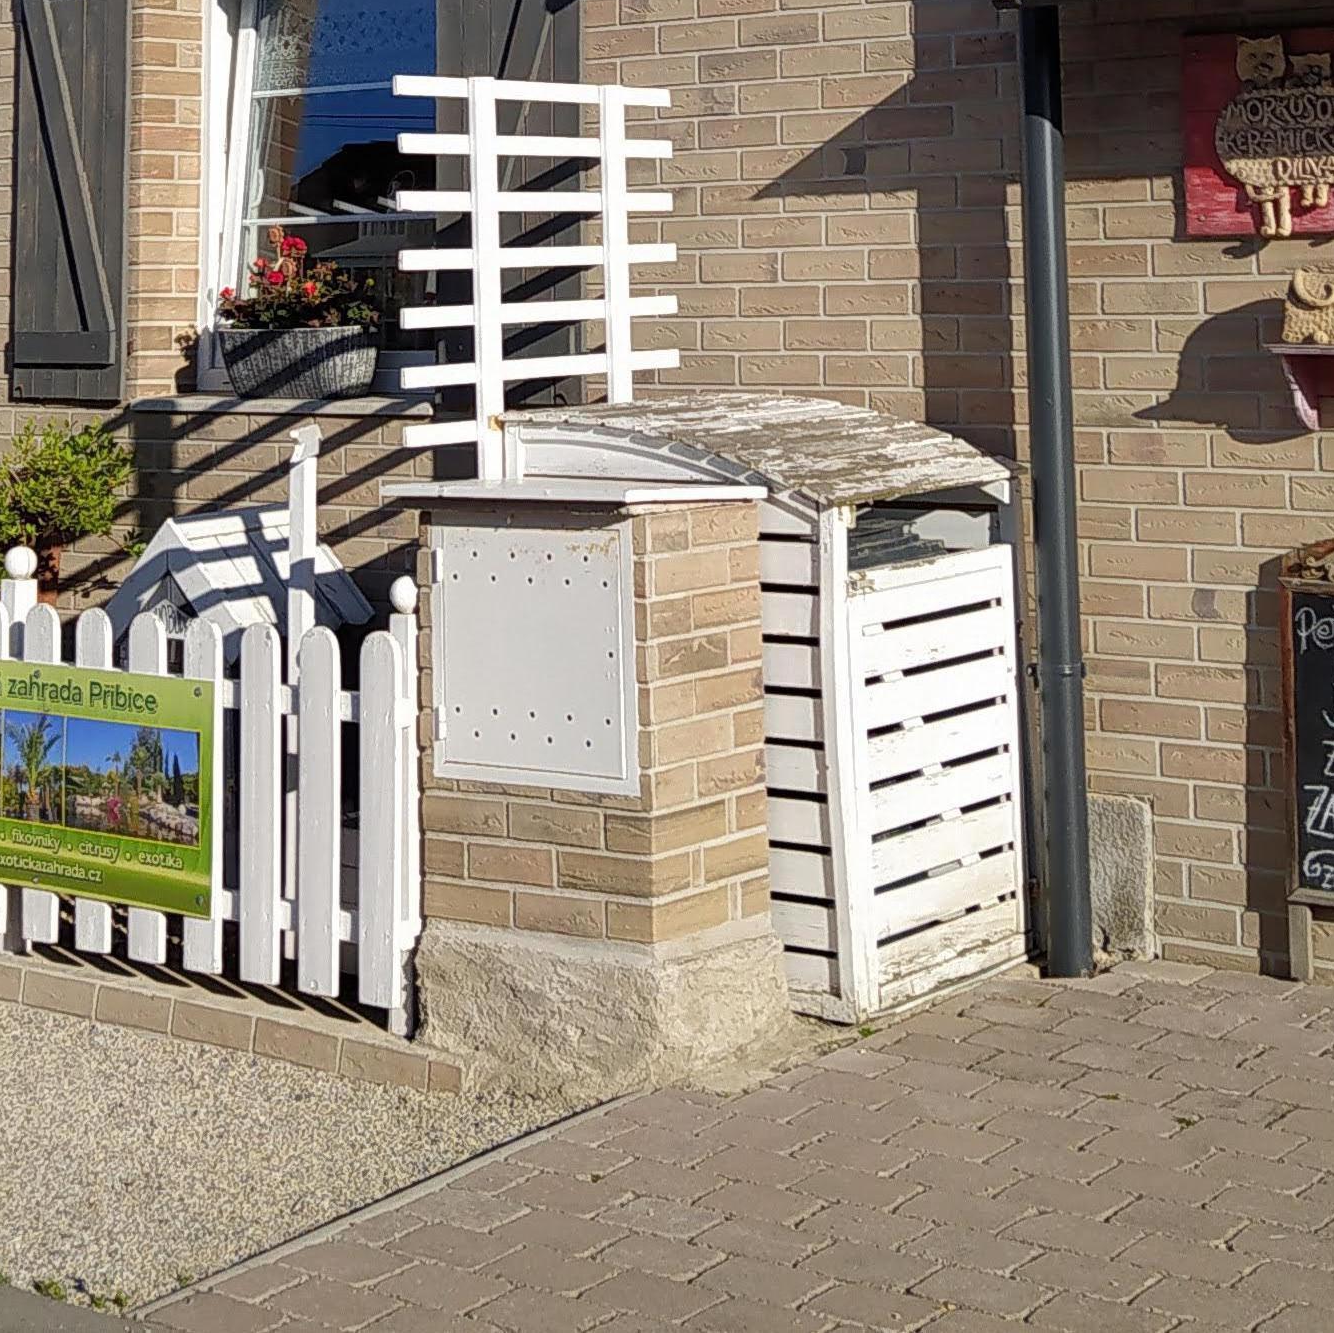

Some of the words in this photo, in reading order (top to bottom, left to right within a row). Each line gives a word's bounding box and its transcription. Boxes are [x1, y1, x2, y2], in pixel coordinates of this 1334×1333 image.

[7, 672, 84, 702] zahrada
[78, 840, 120, 861] citrusy
[137, 849, 184, 870] exotika
